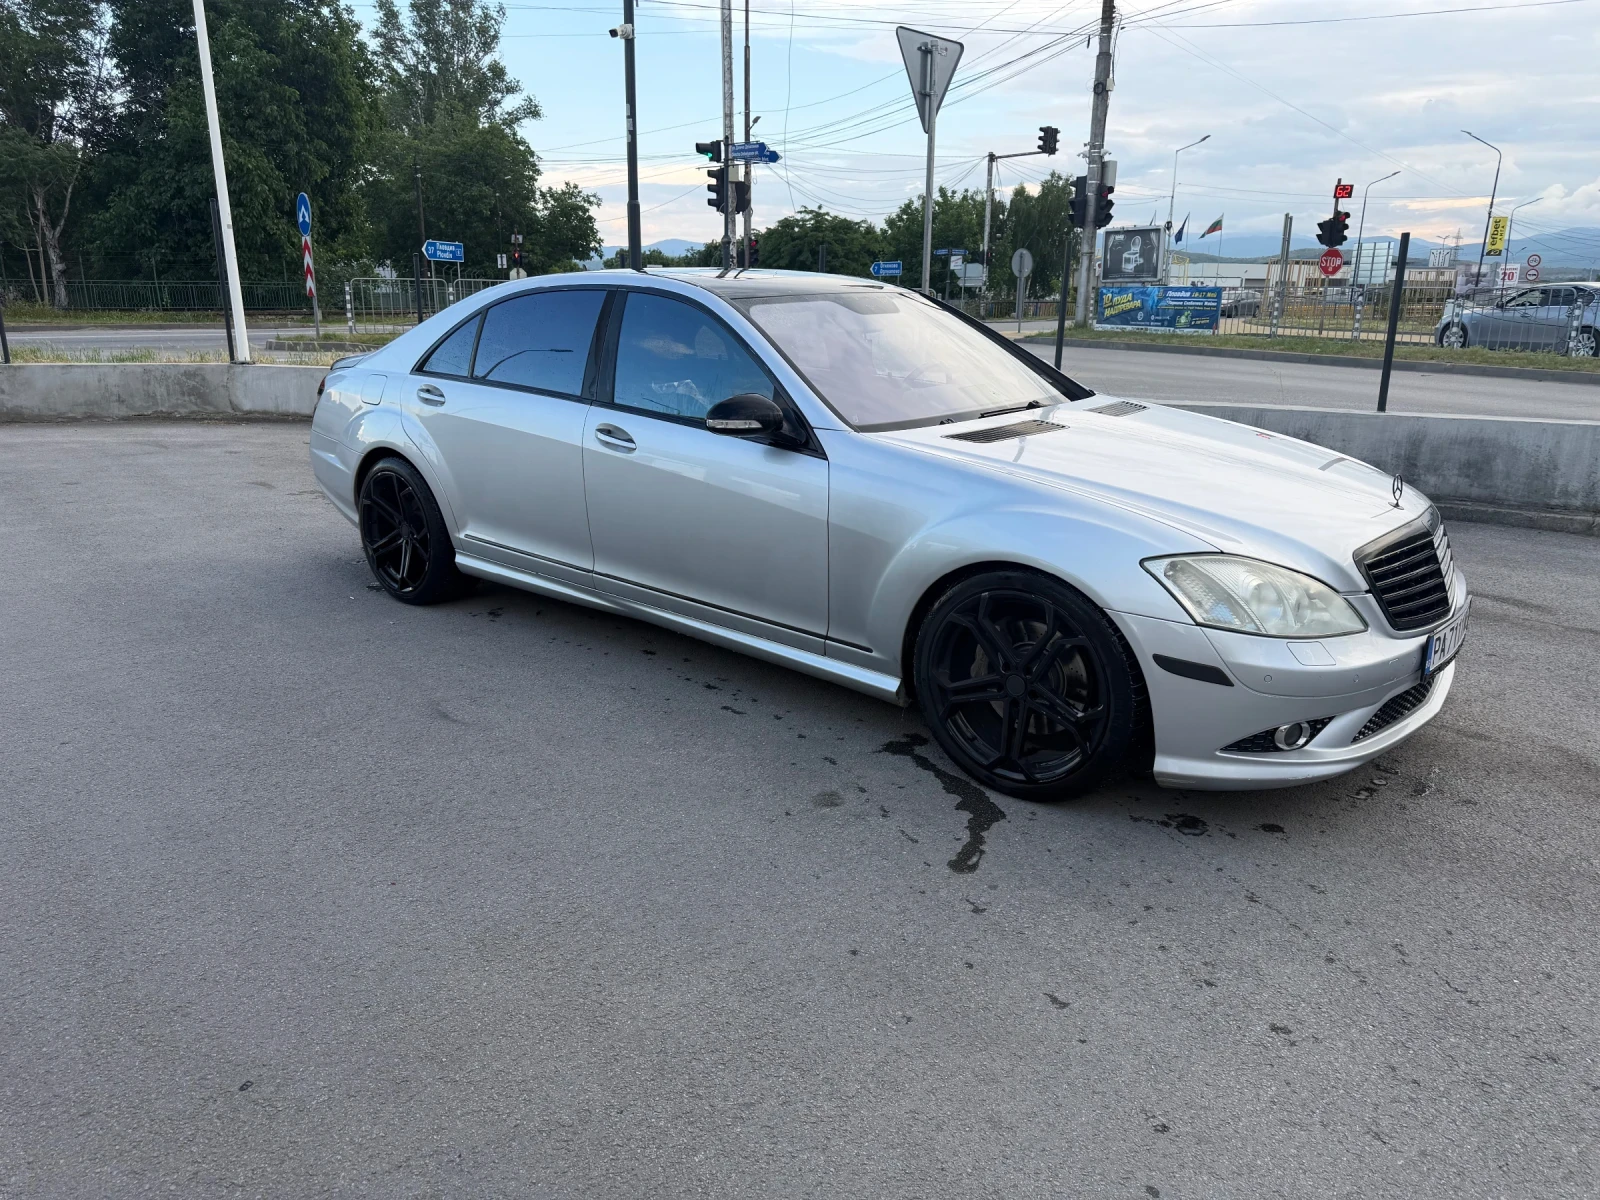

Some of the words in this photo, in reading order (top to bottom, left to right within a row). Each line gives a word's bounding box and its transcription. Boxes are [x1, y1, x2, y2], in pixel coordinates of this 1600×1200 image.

[1336, 185, 1351, 197] 62
[1490, 218, 1502, 246] efbet
[428, 246, 435, 254] 37
[1320, 256, 1342, 267] STOP
[1501, 271, 1515, 281] 20
[1103, 293, 1113, 304] 10
